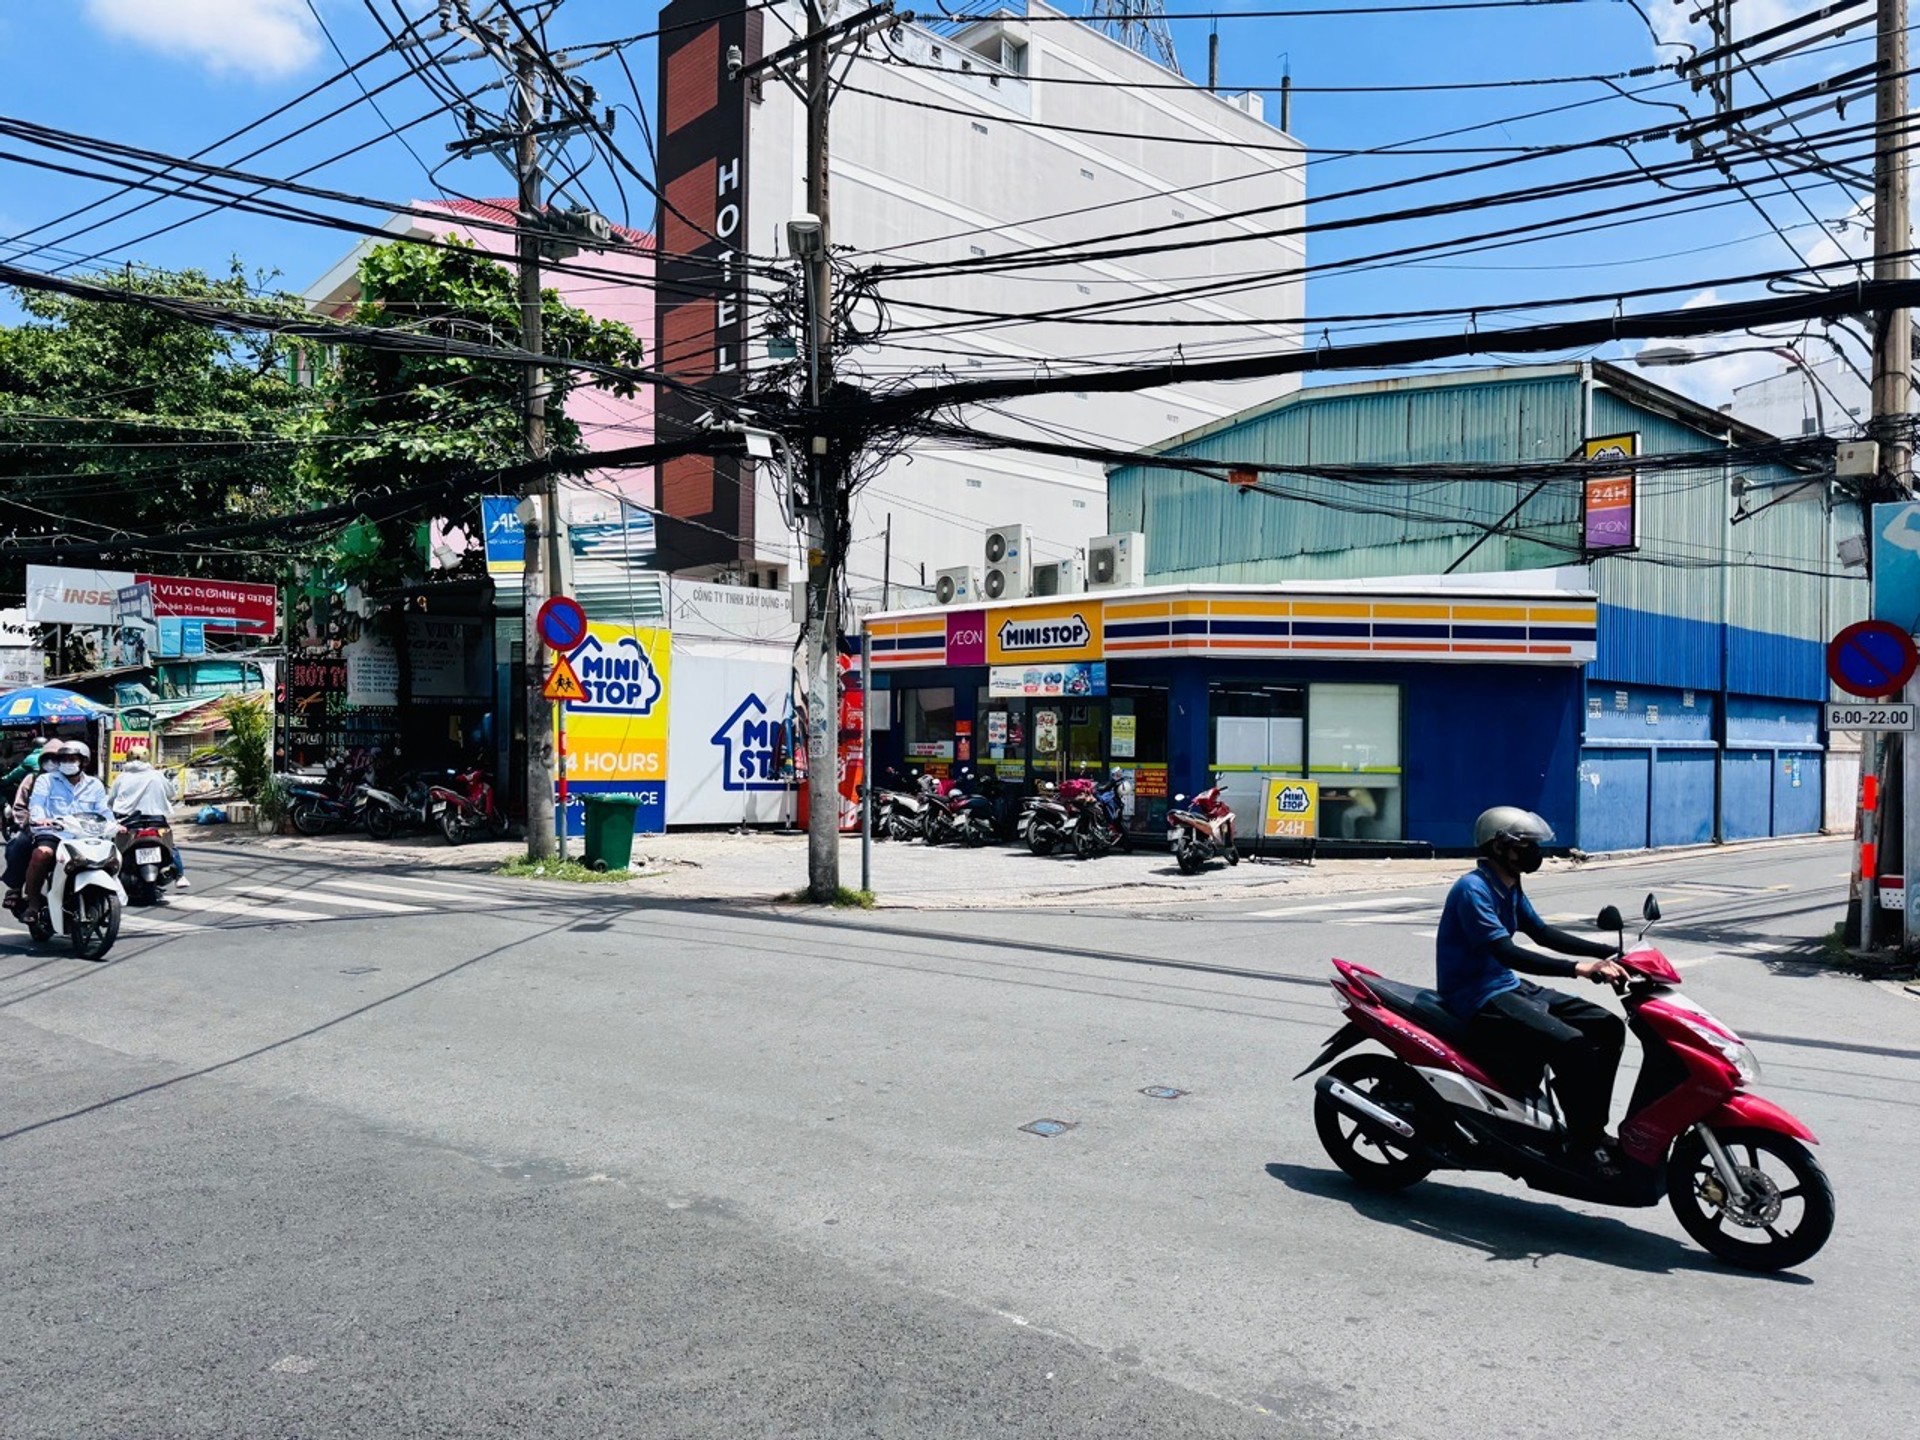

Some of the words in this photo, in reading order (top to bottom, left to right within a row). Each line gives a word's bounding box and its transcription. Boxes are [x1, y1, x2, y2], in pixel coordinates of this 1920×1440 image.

[717, 157, 739, 373] HOTEL
[1592, 486, 1628, 503] 24H
[1006, 625, 1083, 646] MINISTOP
[582, 655, 639, 681] MINI
[584, 682, 642, 705] STOP
[1832, 711, 1908, 725] 6:00-22:00
[584, 752, 659, 772] HOURS
[1282, 801, 1303, 809] STOP
[1284, 792, 1303, 801] MINI
[1275, 821, 1305, 834] 24H
